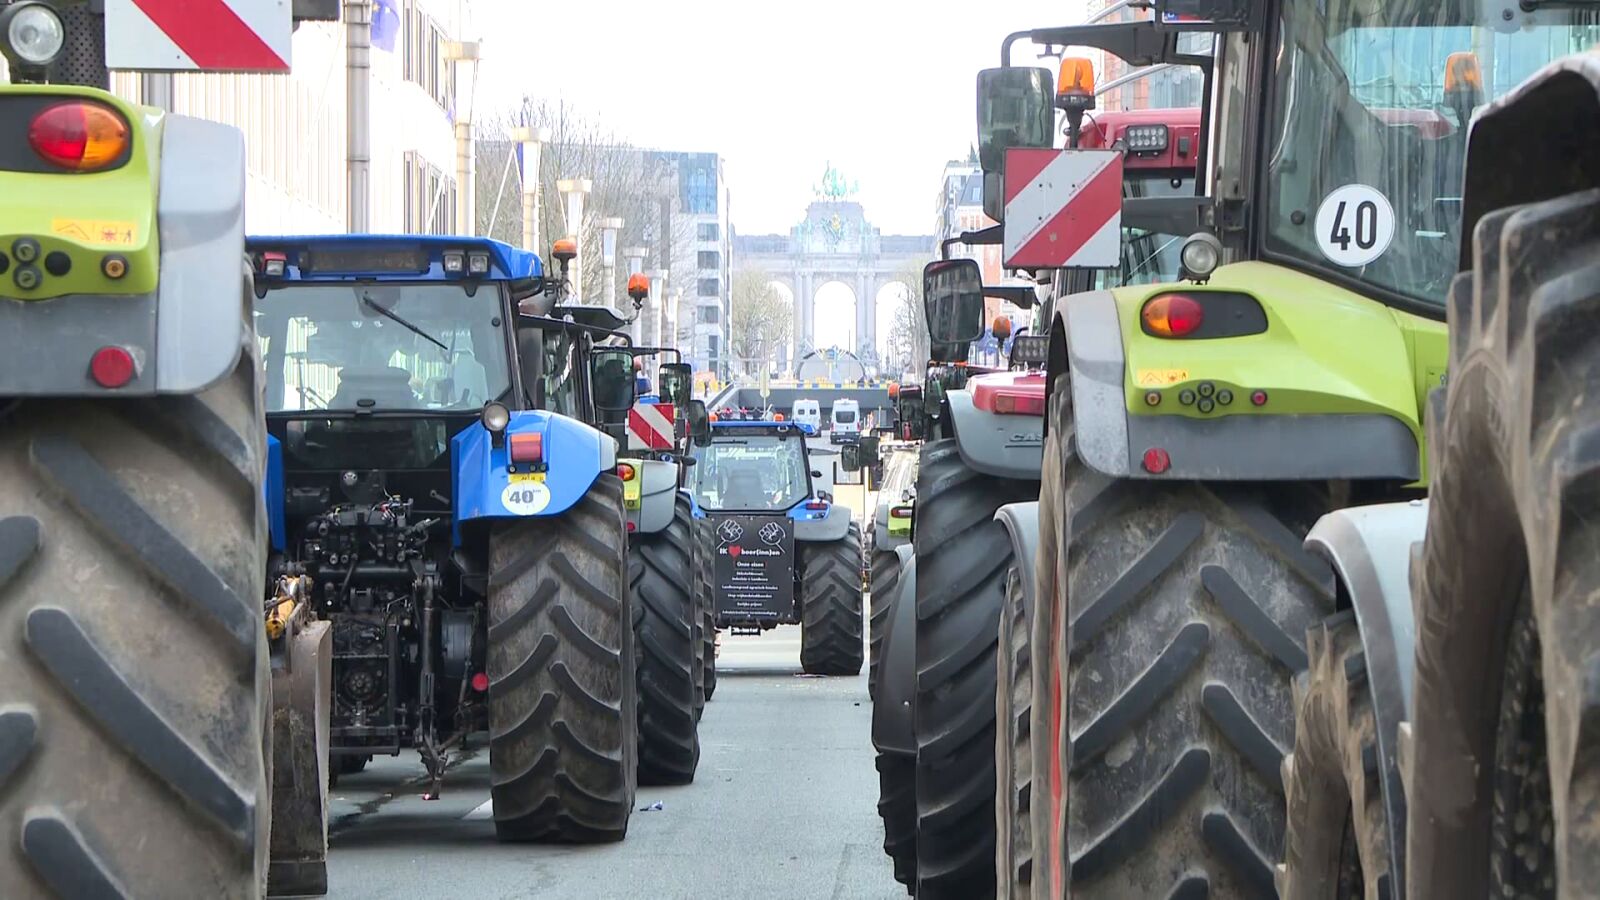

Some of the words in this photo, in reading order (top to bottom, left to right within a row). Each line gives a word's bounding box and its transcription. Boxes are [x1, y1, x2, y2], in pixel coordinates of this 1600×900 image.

[1330, 200, 1377, 251] 40
[1010, 432, 1043, 442] CAS
[509, 490, 534, 504] 40
